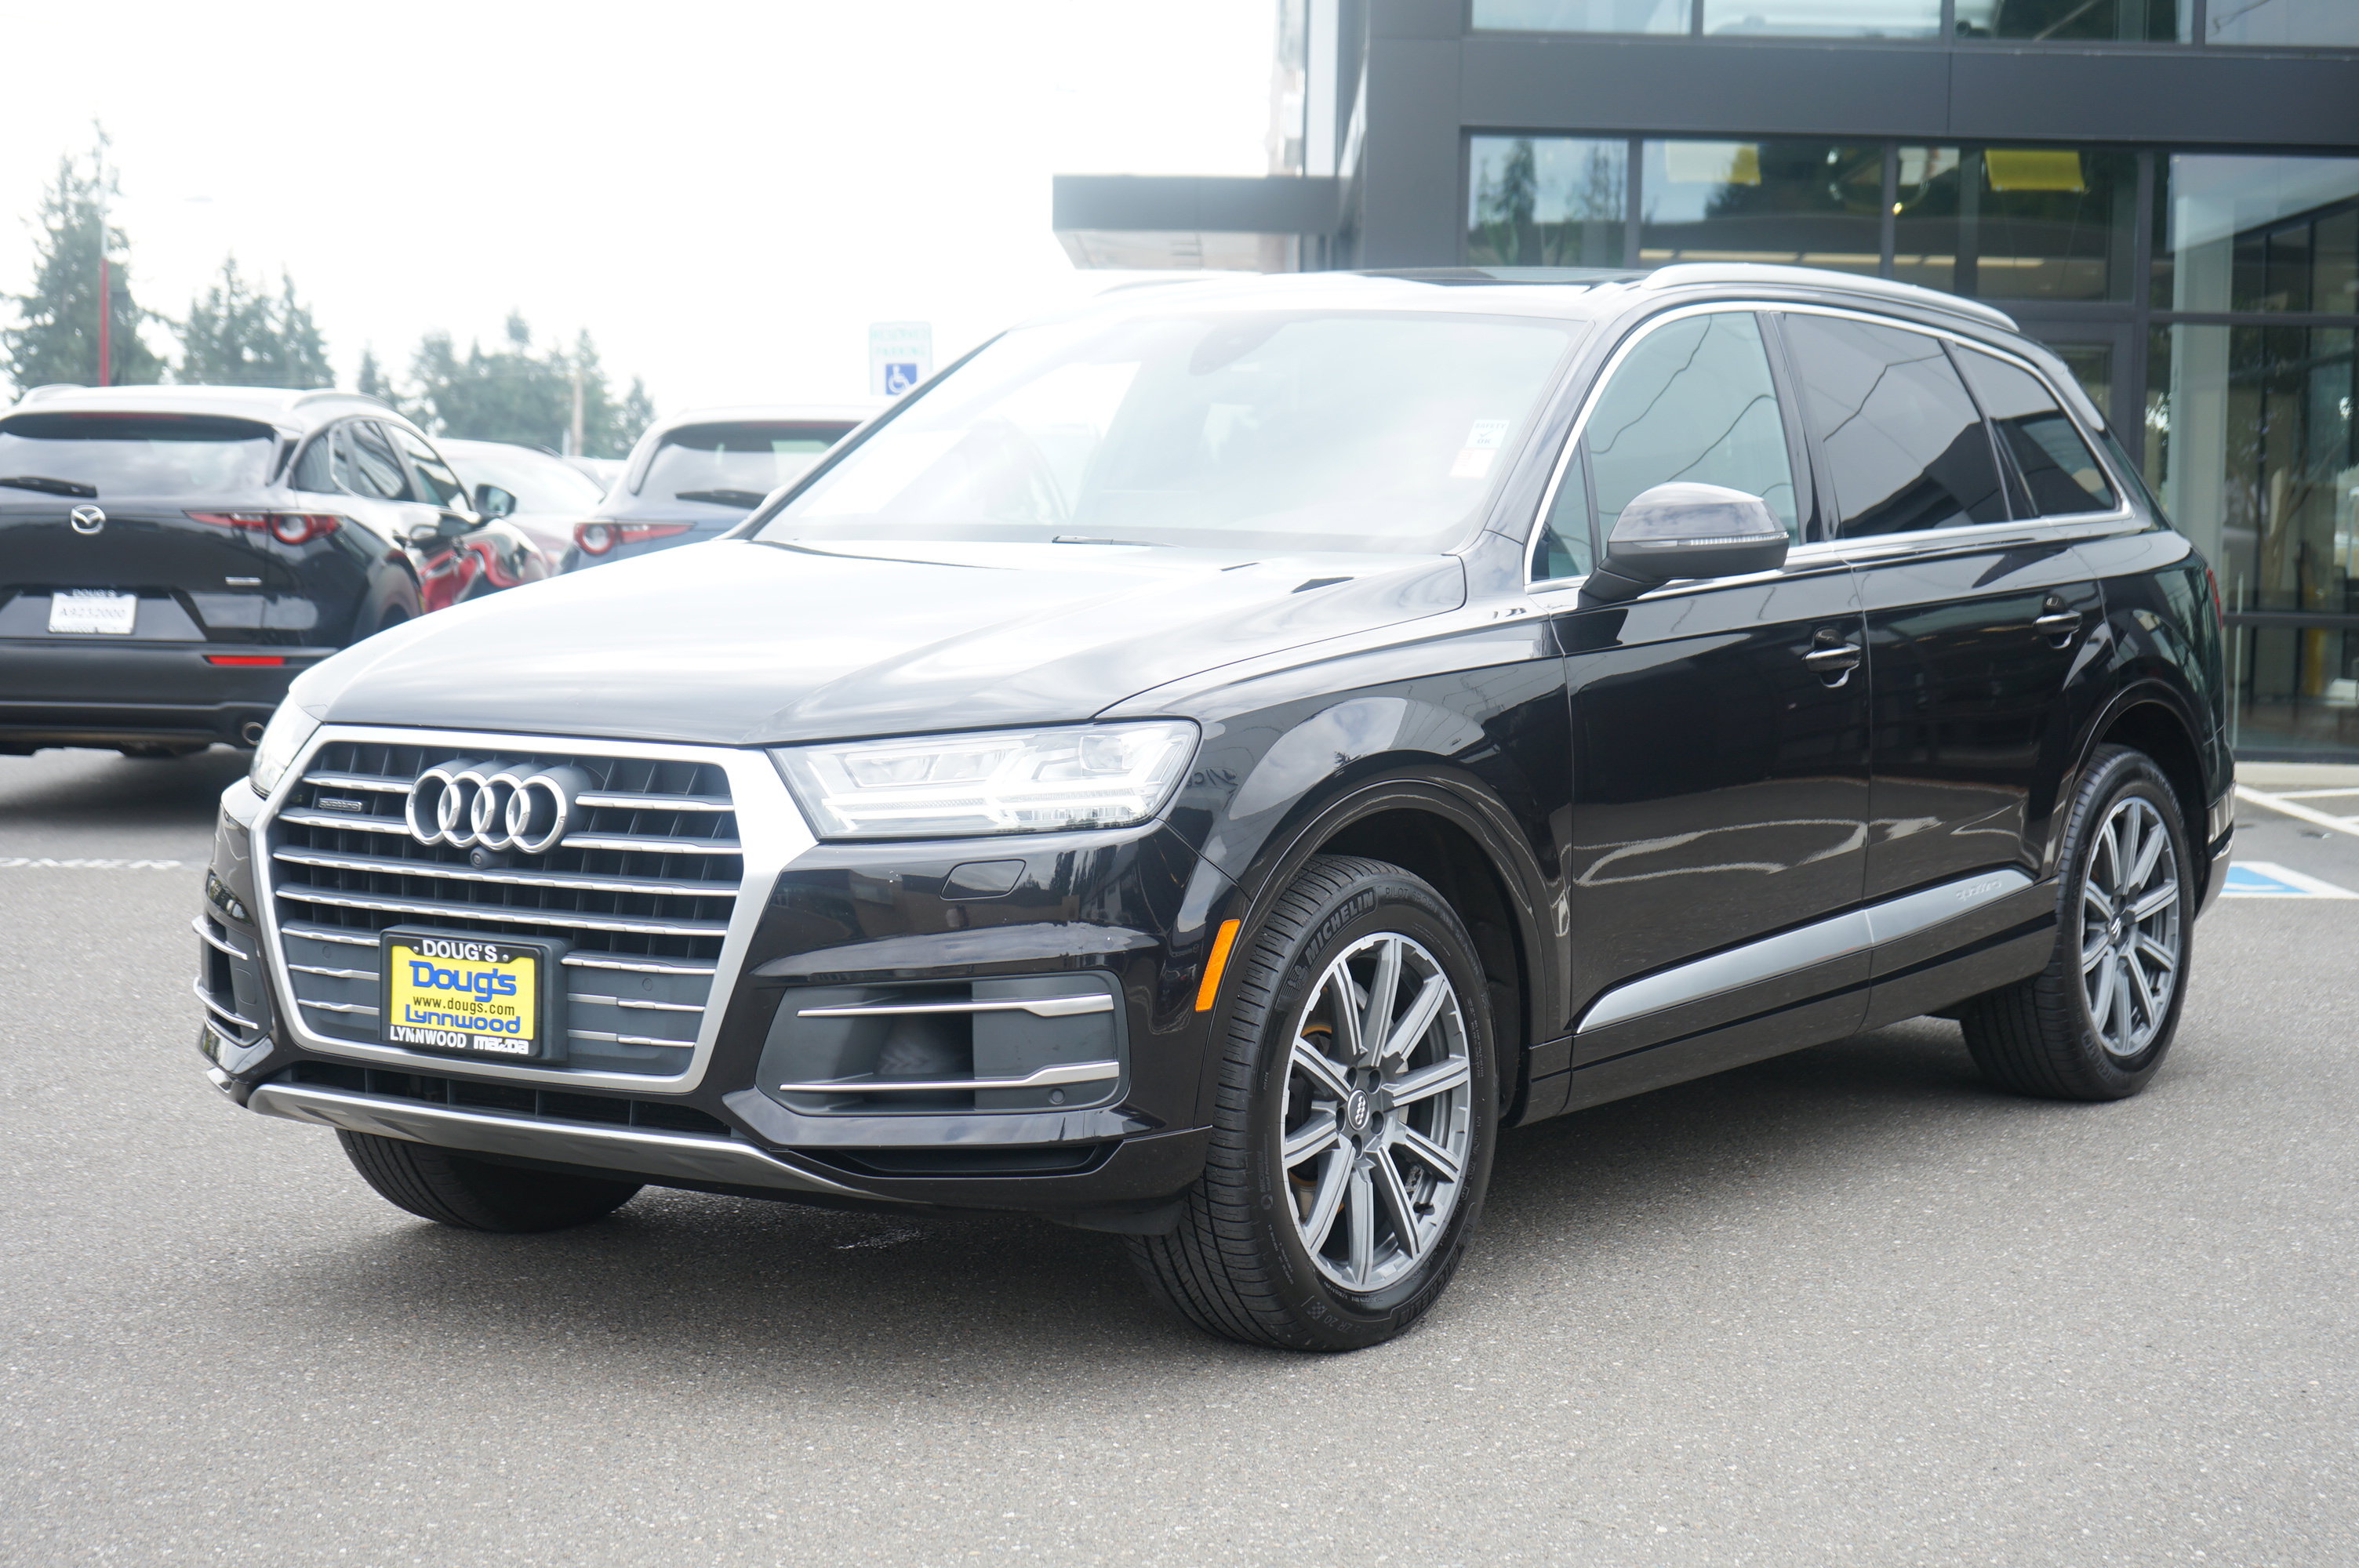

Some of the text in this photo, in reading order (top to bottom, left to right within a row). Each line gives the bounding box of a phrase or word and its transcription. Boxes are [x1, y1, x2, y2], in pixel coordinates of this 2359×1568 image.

[1385, 887, 1409, 899] PILOT
[1304, 890, 1374, 966] MICHELIN
[422, 939, 498, 963] DOUG'S
[409, 960, 517, 1003] Doug's
[413, 995, 515, 1016] www.dougs.com
[405, 1004, 521, 1034] Lynnwood
[390, 1025, 467, 1049] LYNNWOOD
[1323, 1315, 1339, 1327] 20
